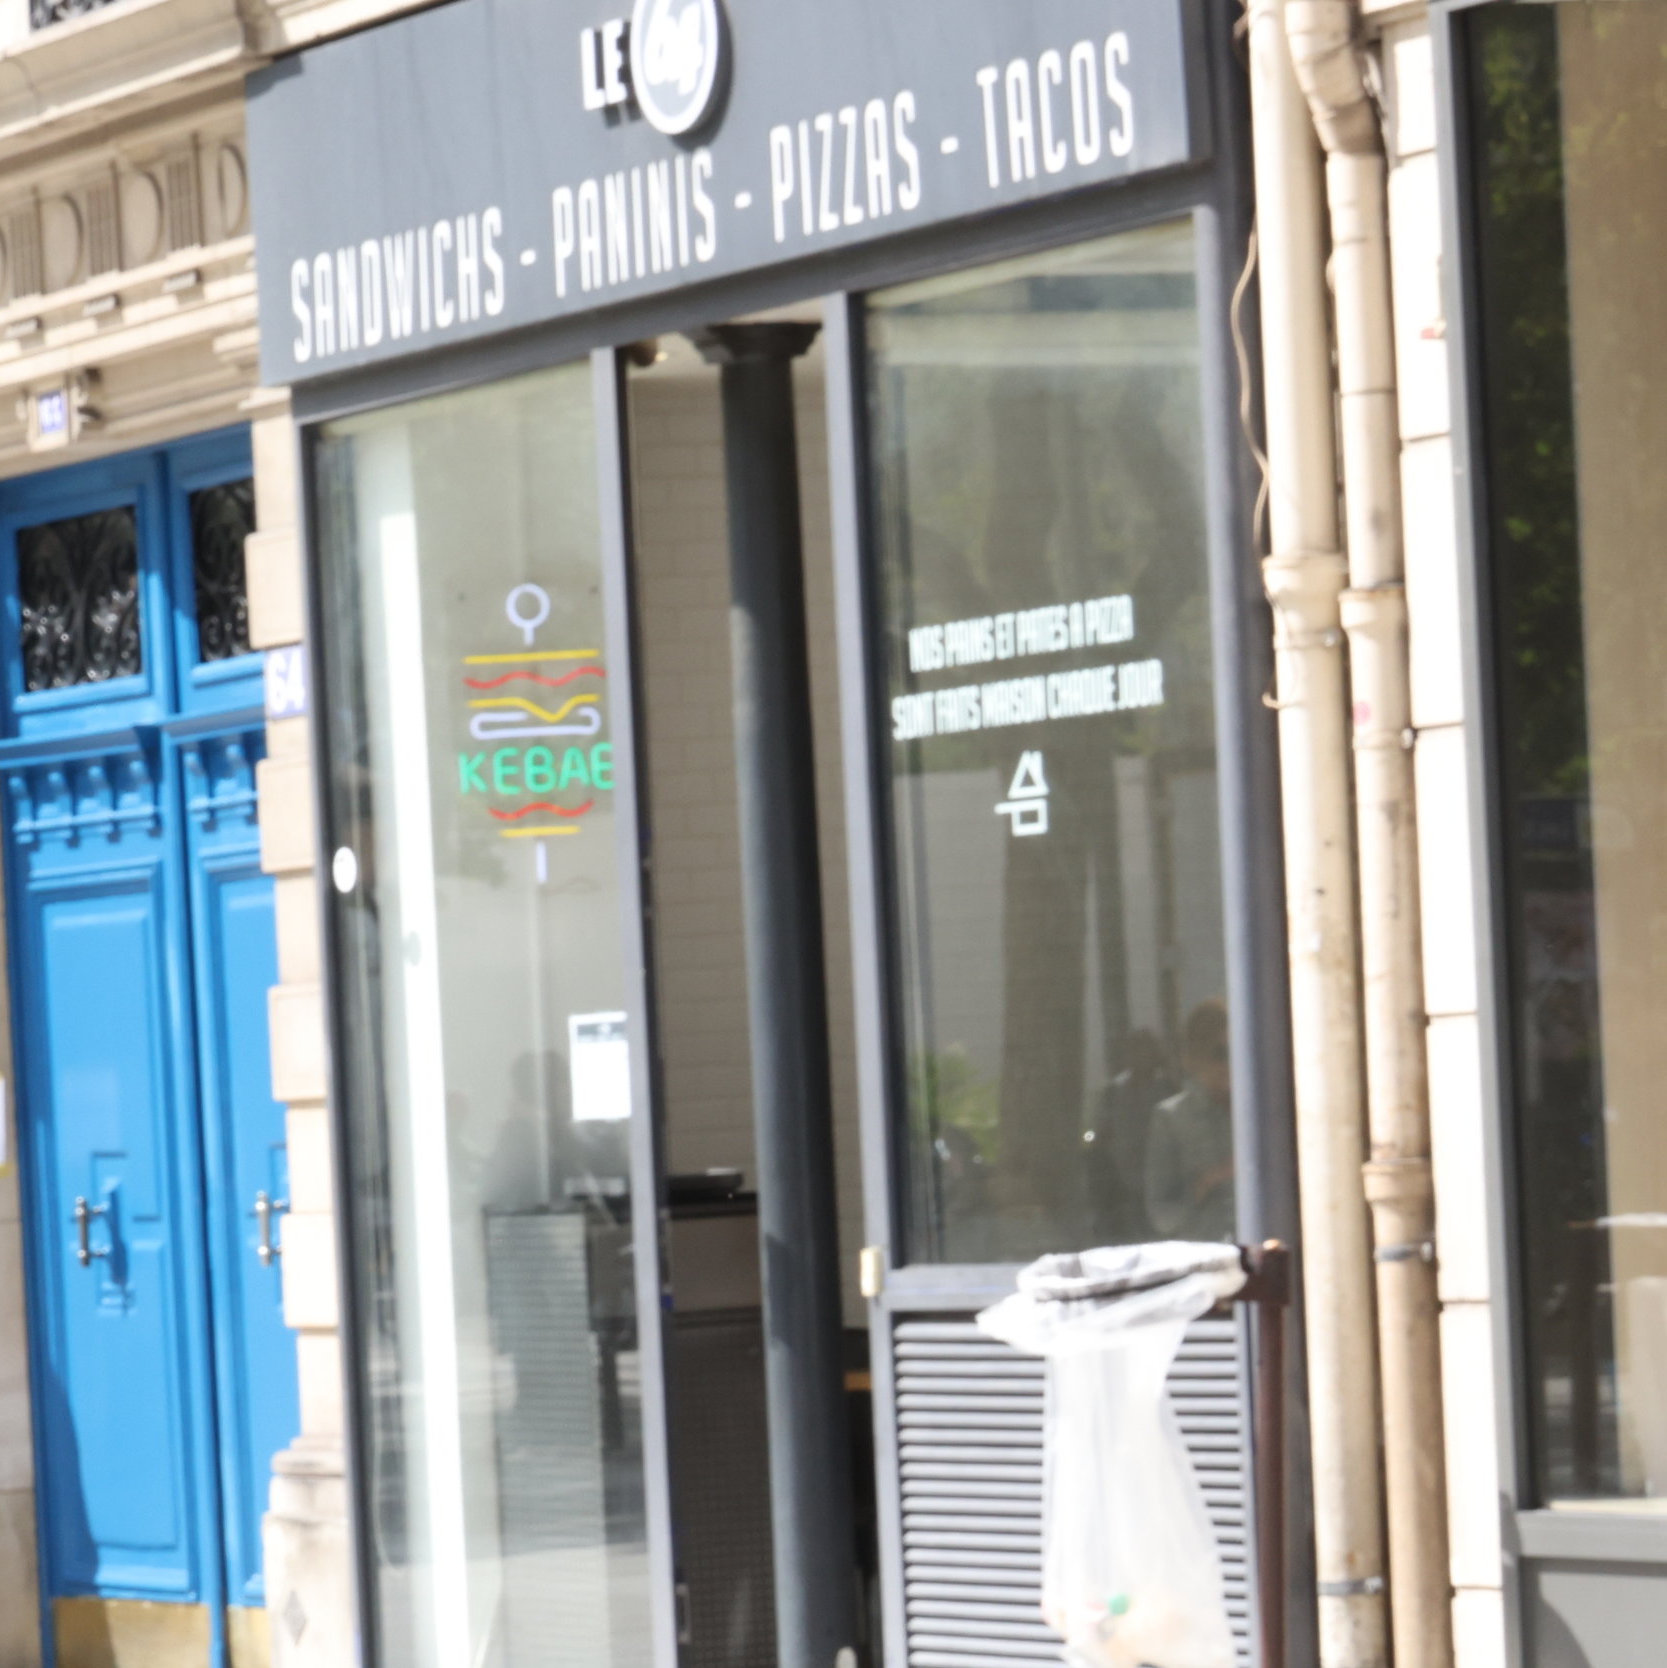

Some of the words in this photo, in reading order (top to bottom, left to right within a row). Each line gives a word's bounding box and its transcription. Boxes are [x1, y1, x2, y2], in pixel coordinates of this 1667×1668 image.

[580, 18, 628, 110] LE
[291, 205, 505, 362] SANDWICHS
[552, 146, 717, 298] PANINIS
[770, 90, 921, 244] PIZZAS
[976, 31, 1134, 188] TACOS
[267, 648, 306, 713] 64
